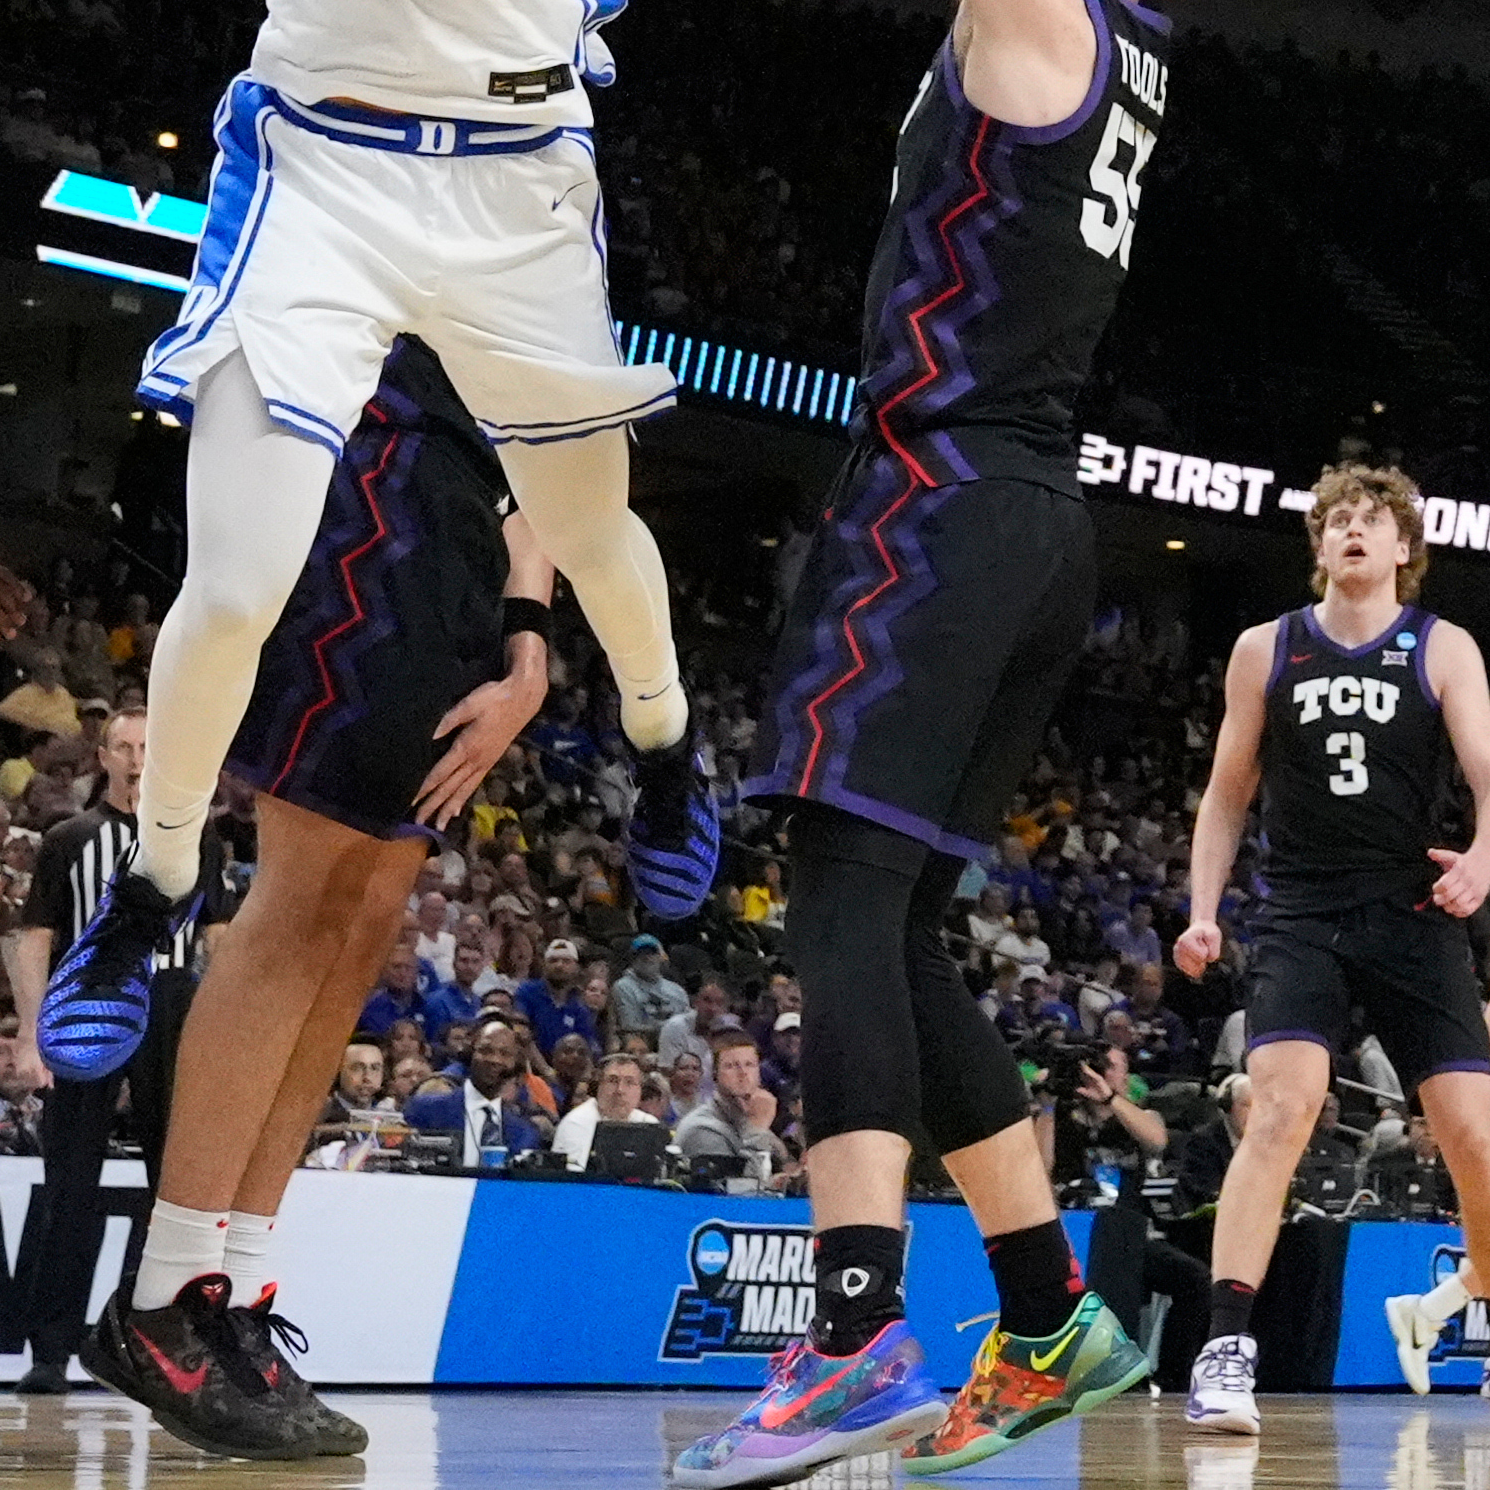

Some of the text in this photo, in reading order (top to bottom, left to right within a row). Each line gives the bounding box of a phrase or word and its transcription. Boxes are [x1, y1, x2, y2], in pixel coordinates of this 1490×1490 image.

[416, 120, 457, 155] D
[1128, 445, 1274, 516] FIRST
[1293, 676, 1400, 725] TCU
[1325, 732, 1369, 796] 3
[726, 1233, 817, 1283] MAR
